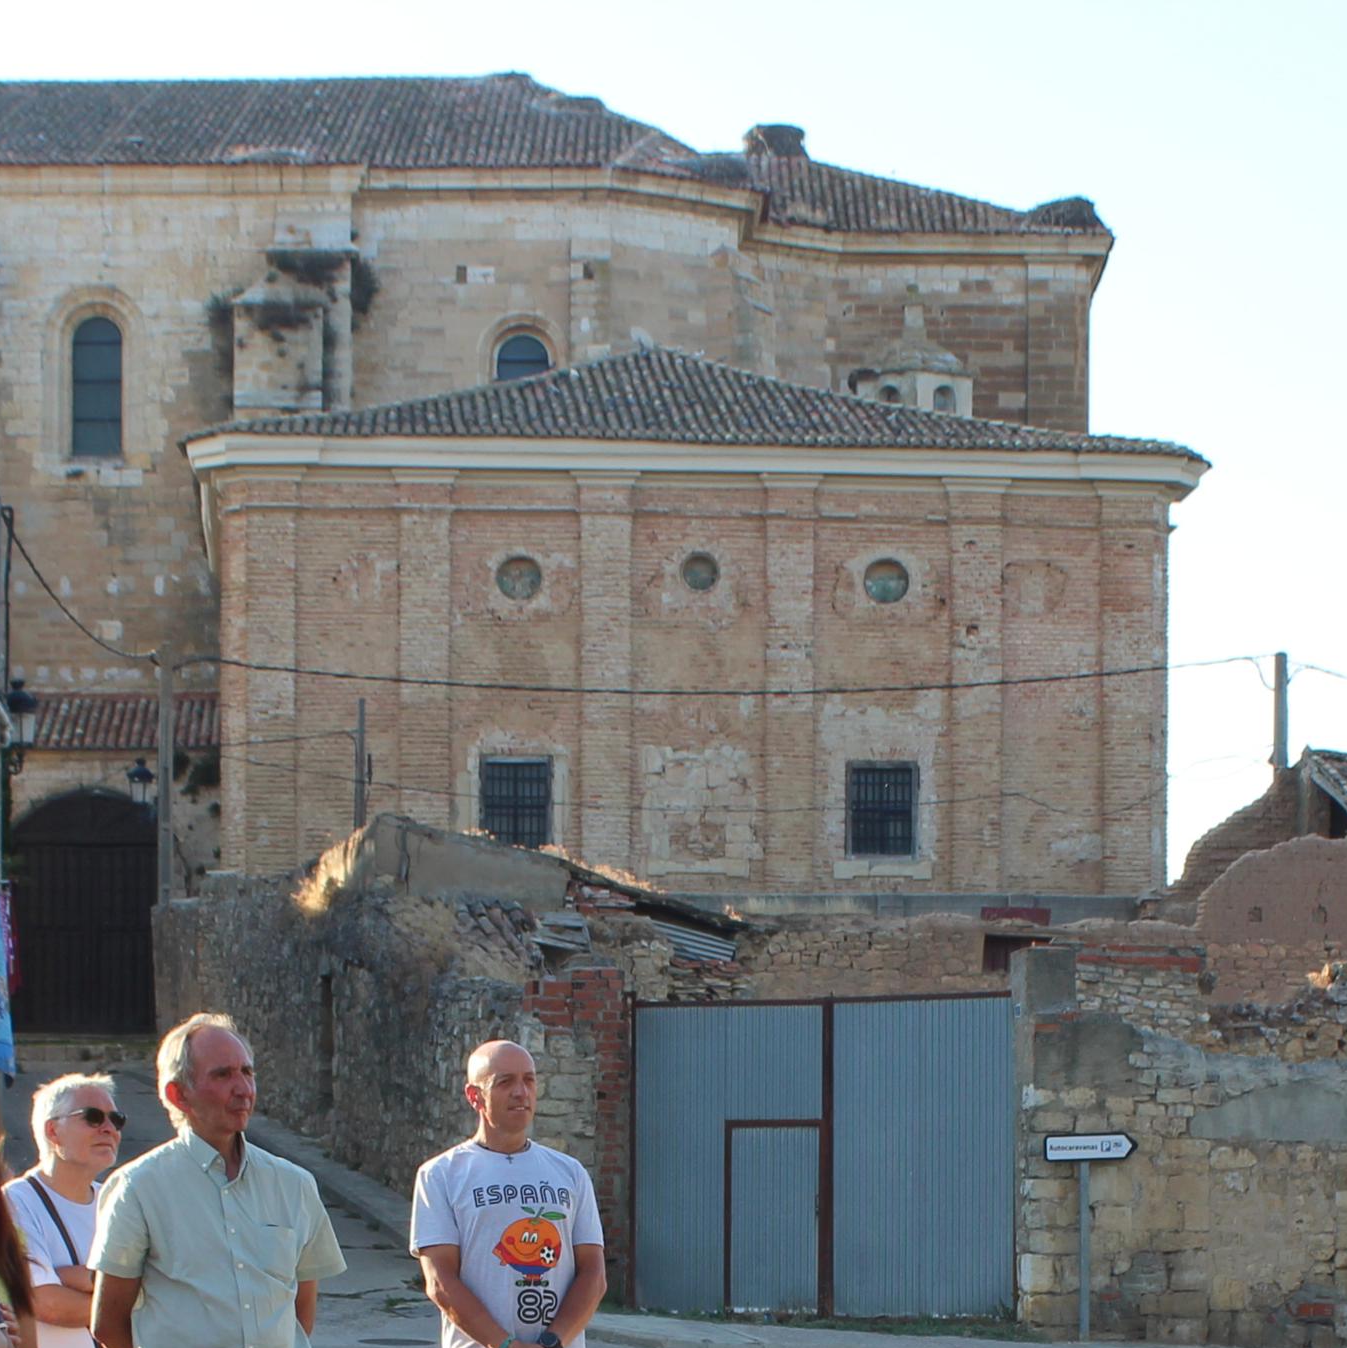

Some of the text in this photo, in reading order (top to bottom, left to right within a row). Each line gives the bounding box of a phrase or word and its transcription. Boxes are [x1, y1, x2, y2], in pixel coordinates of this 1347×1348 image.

[1049, 1143, 1098, 1152] Autocaravanas
[473, 1181, 571, 1209] ESPAÑA
[517, 1289, 558, 1326] 82
